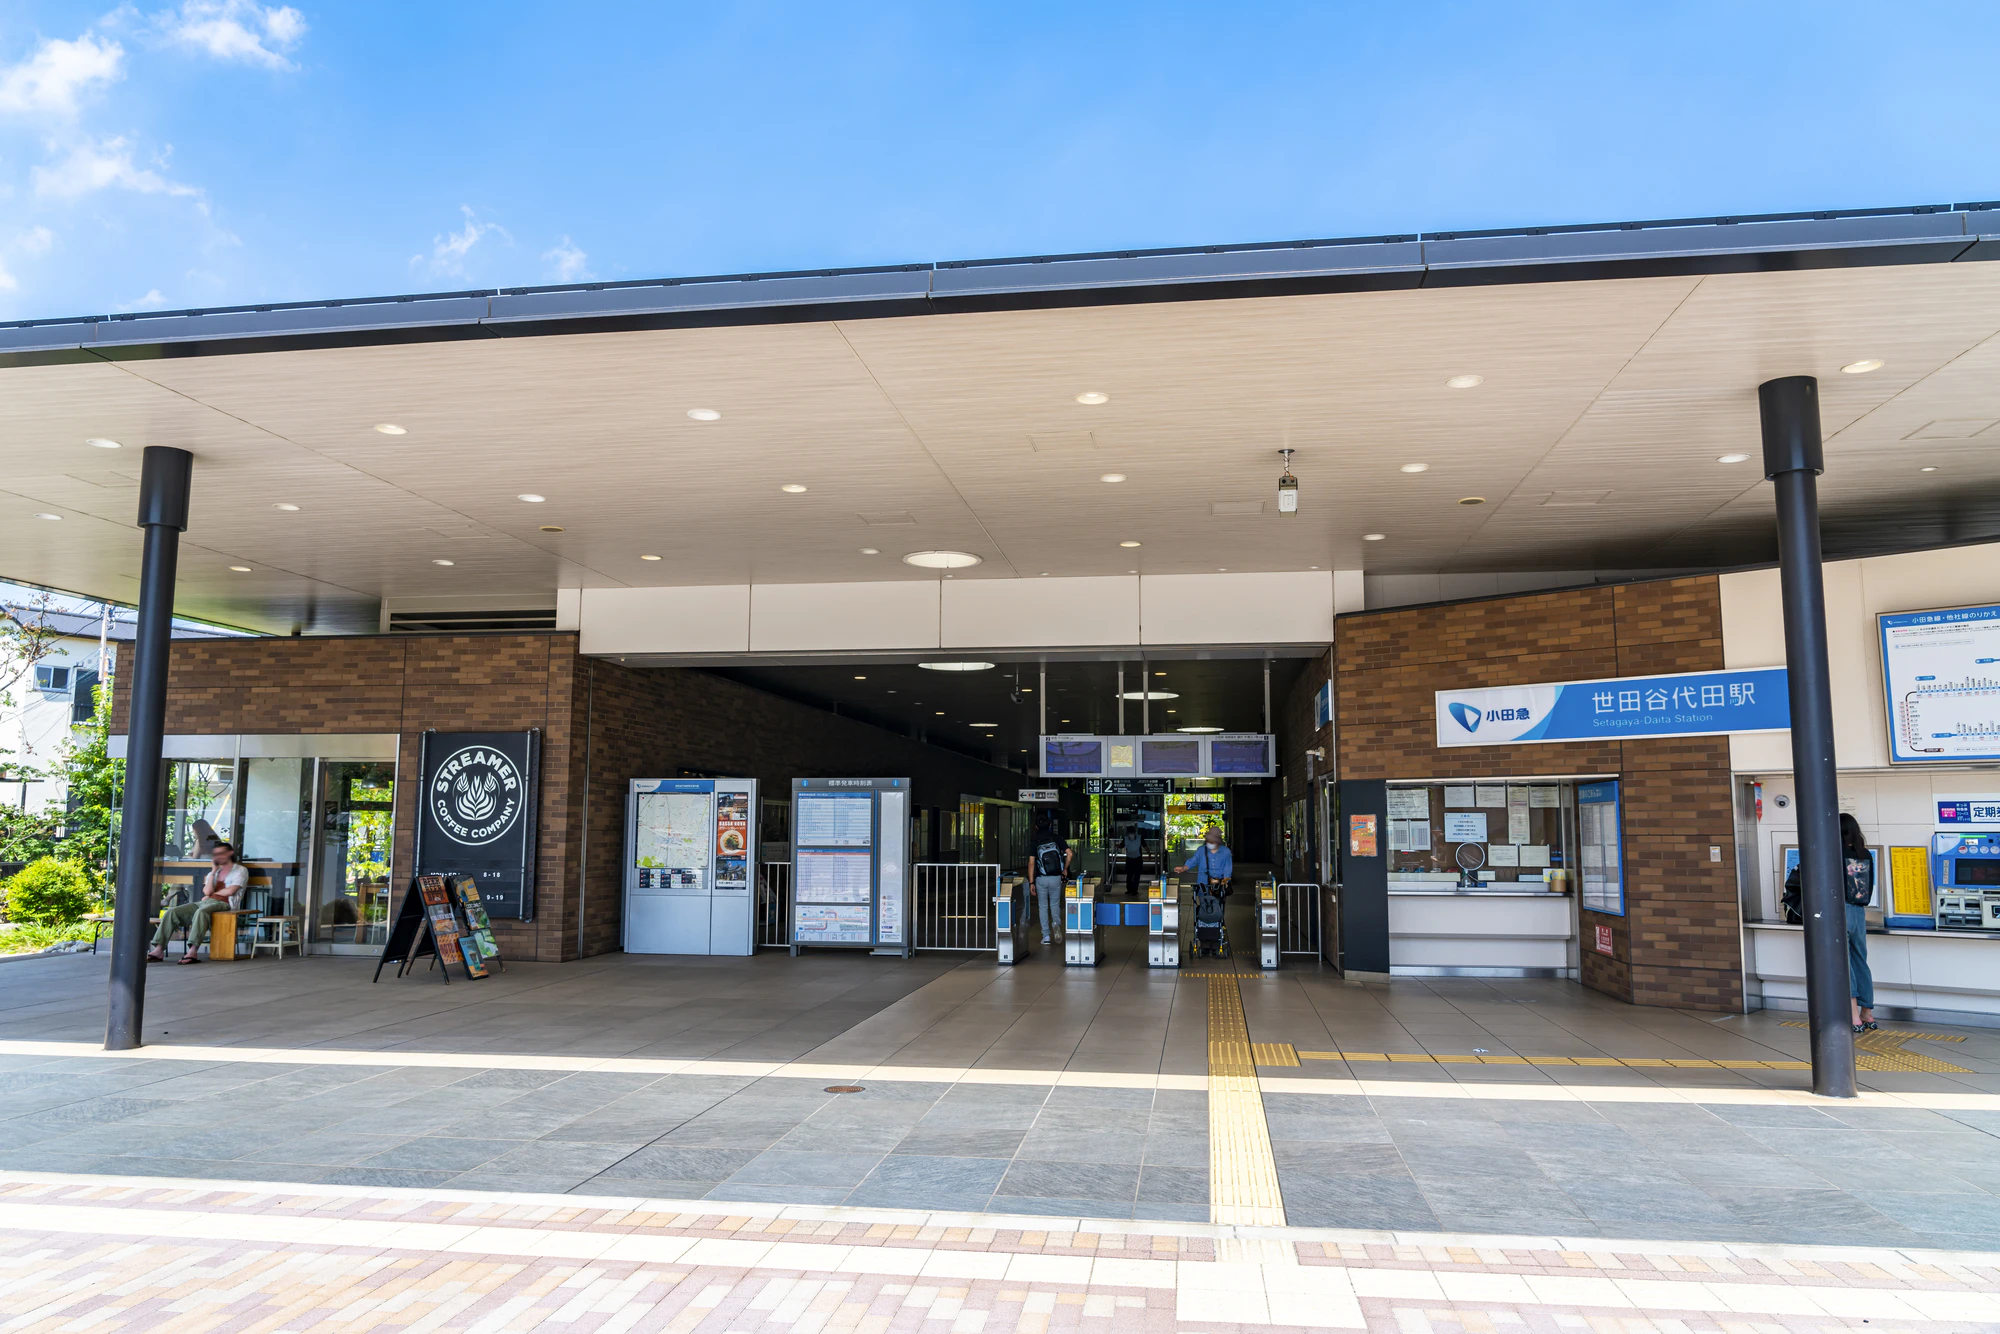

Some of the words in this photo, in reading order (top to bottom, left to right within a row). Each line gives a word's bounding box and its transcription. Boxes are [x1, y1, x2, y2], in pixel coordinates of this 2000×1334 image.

[1912, 611, 1998, 624] 小田急線・他社線のりかえ
[1592, 682, 1756, 714] 世田谷代田駅
[1486, 708, 1530, 722] 小田急
[1592, 716, 1671, 728] Setagaya-Daita
[1675, 713, 1713, 723] Station
[437, 751, 517, 793] STREAMER
[1104, 780, 1113, 792] 2
[1165, 779, 1171, 792] 1
[437, 799, 468, 837] COFFEE
[471, 798, 515, 838] COMPANY
